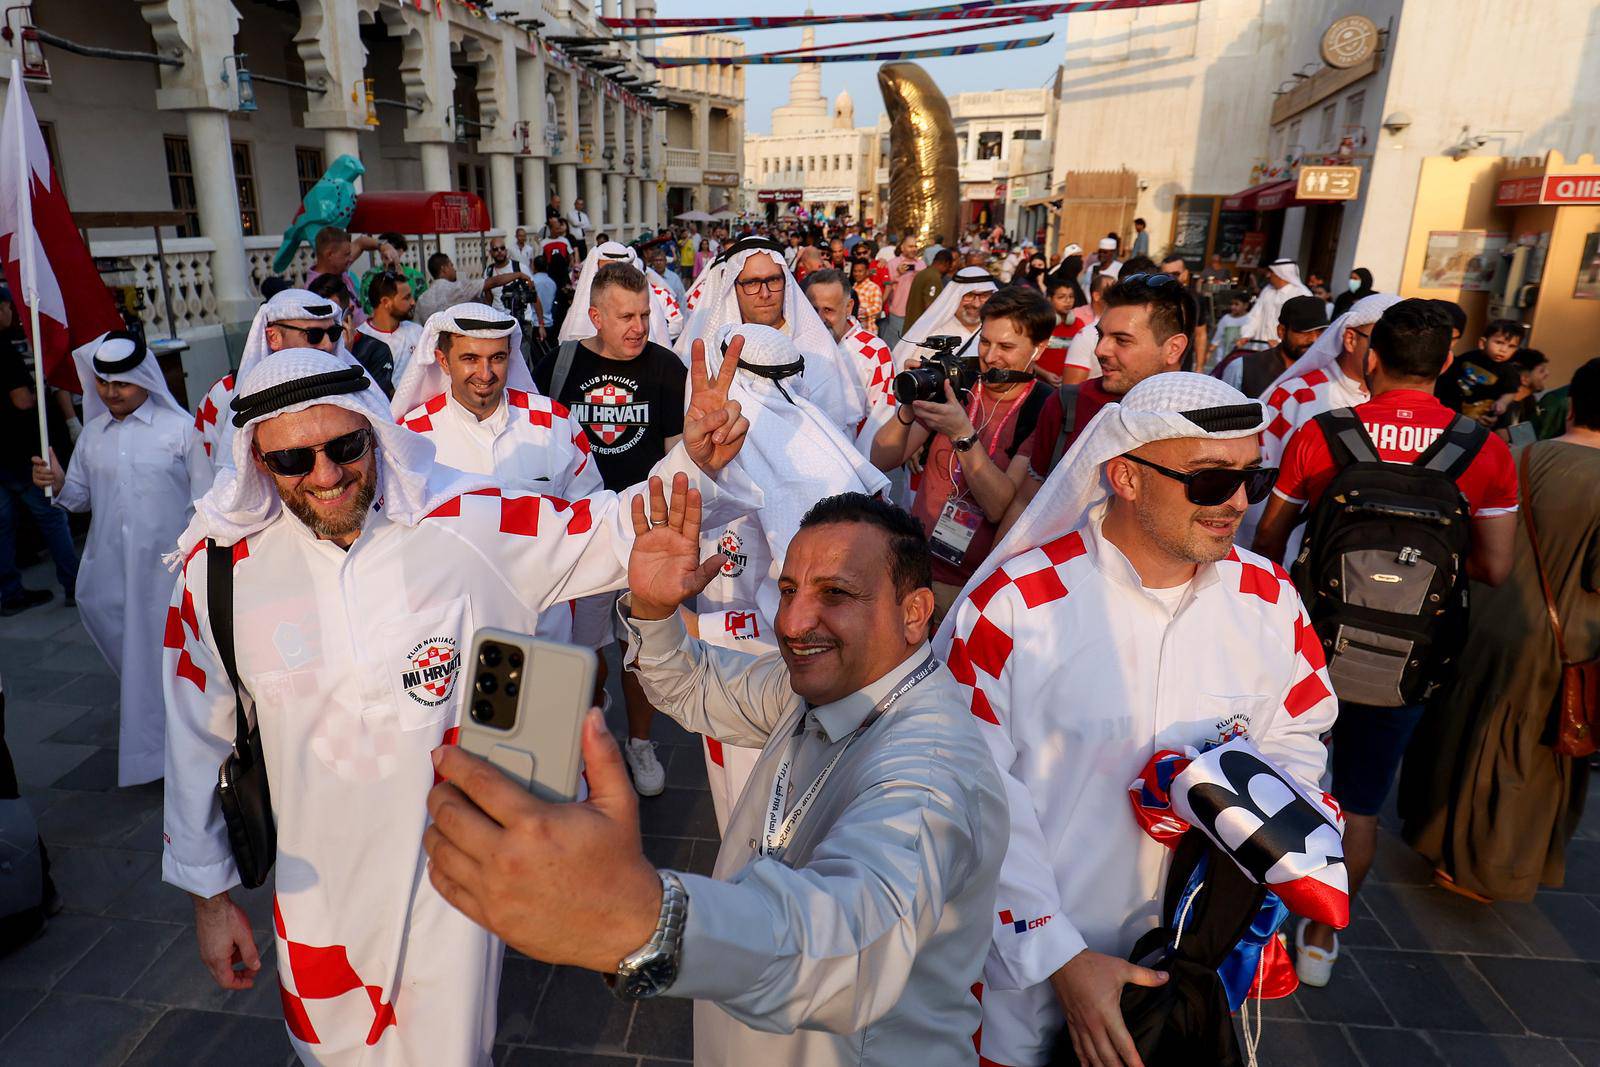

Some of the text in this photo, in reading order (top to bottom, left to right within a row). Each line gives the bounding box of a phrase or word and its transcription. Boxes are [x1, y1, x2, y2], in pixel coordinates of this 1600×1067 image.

[580, 376, 601, 391] KLUB
[571, 403, 649, 423] MI HRVATI
[598, 426, 646, 455] REPREZENTACIJE
[407, 643, 423, 660] KLUB
[402, 652, 462, 690] MI HRVATI
[916, 668, 929, 681] FIFA
[407, 690, 435, 707] HRVATSKE
[772, 797, 781, 811] FIFA
[801, 793, 812, 808] CUP
